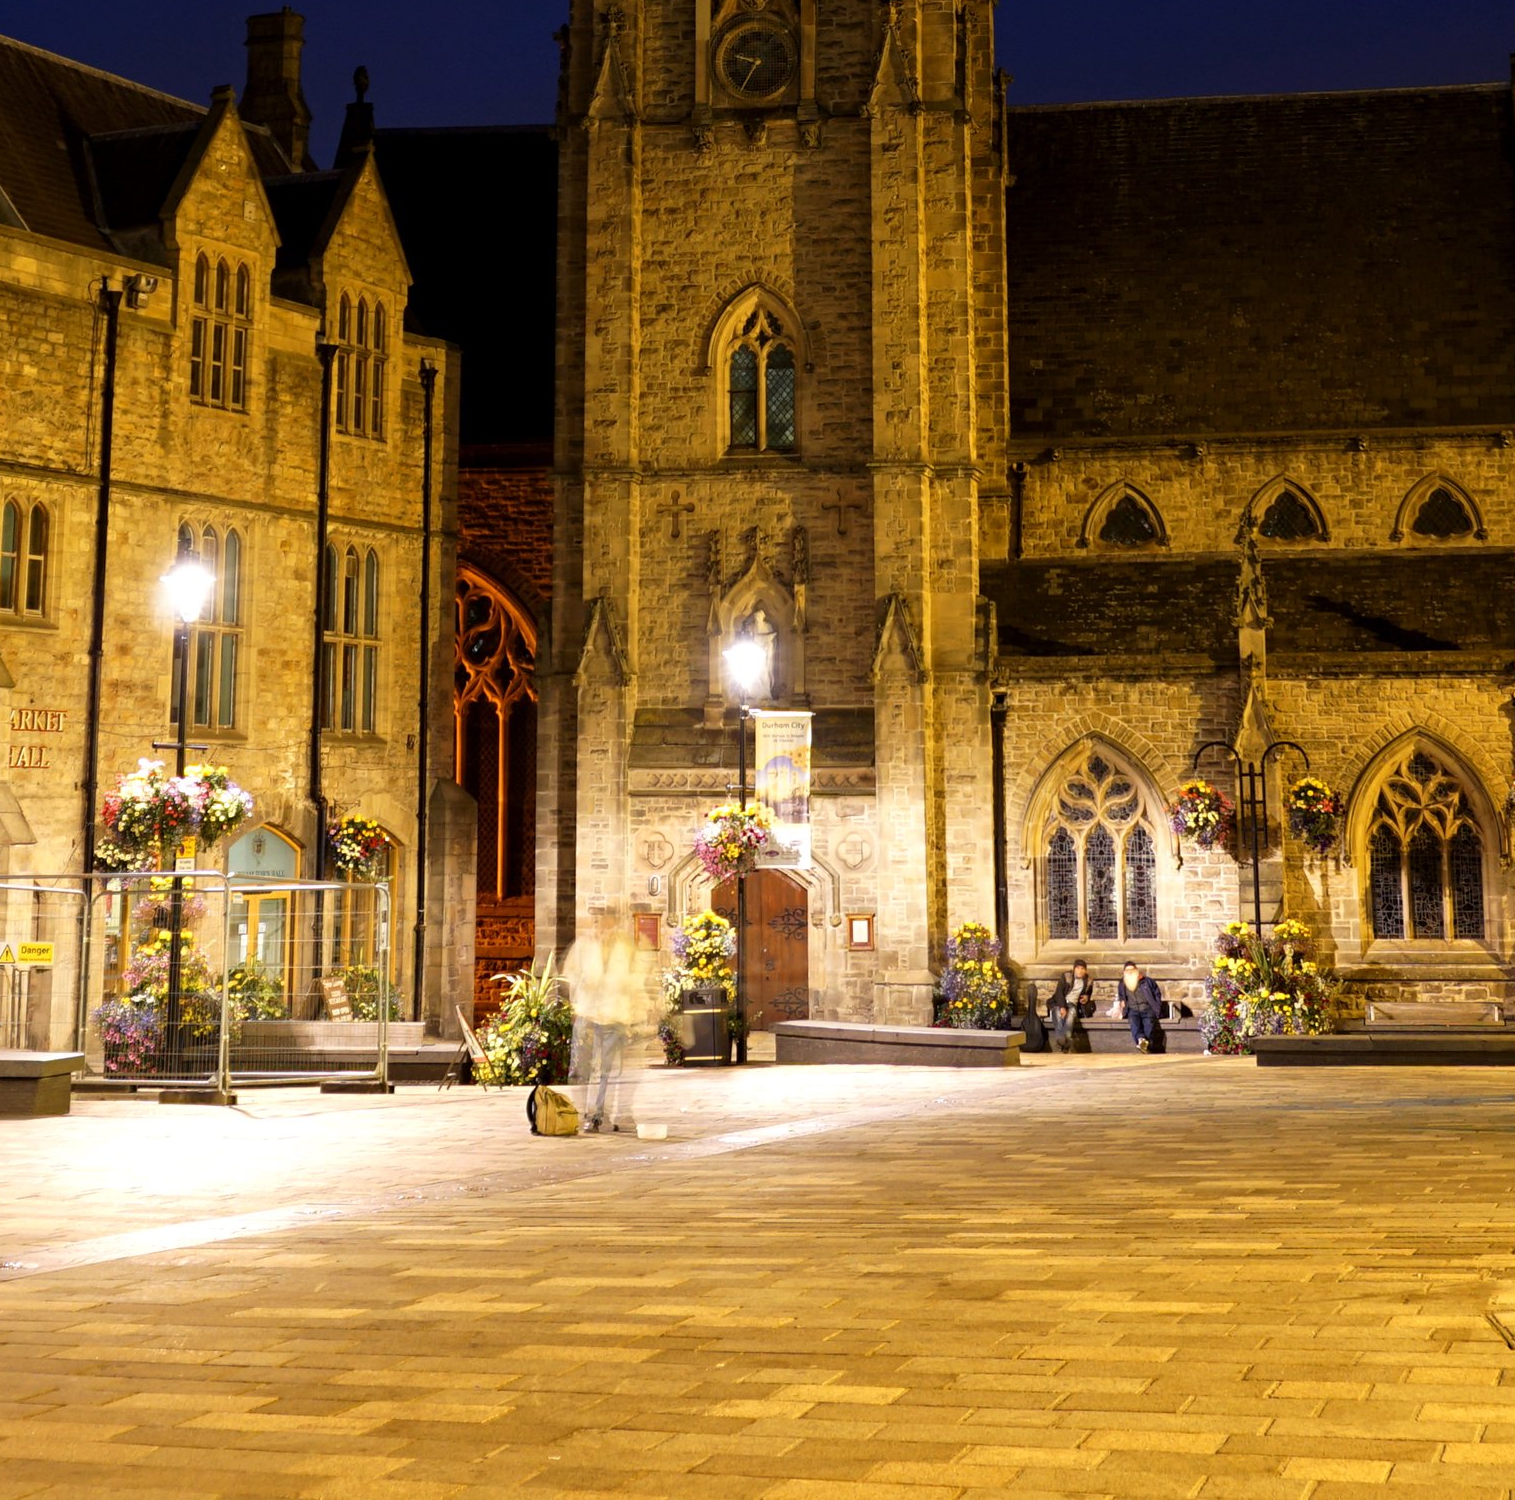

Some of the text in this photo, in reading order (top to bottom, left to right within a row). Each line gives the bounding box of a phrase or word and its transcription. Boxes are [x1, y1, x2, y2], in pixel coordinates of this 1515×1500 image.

[762, 721, 805, 730] Durham City
[21, 945, 51, 957] Danger
